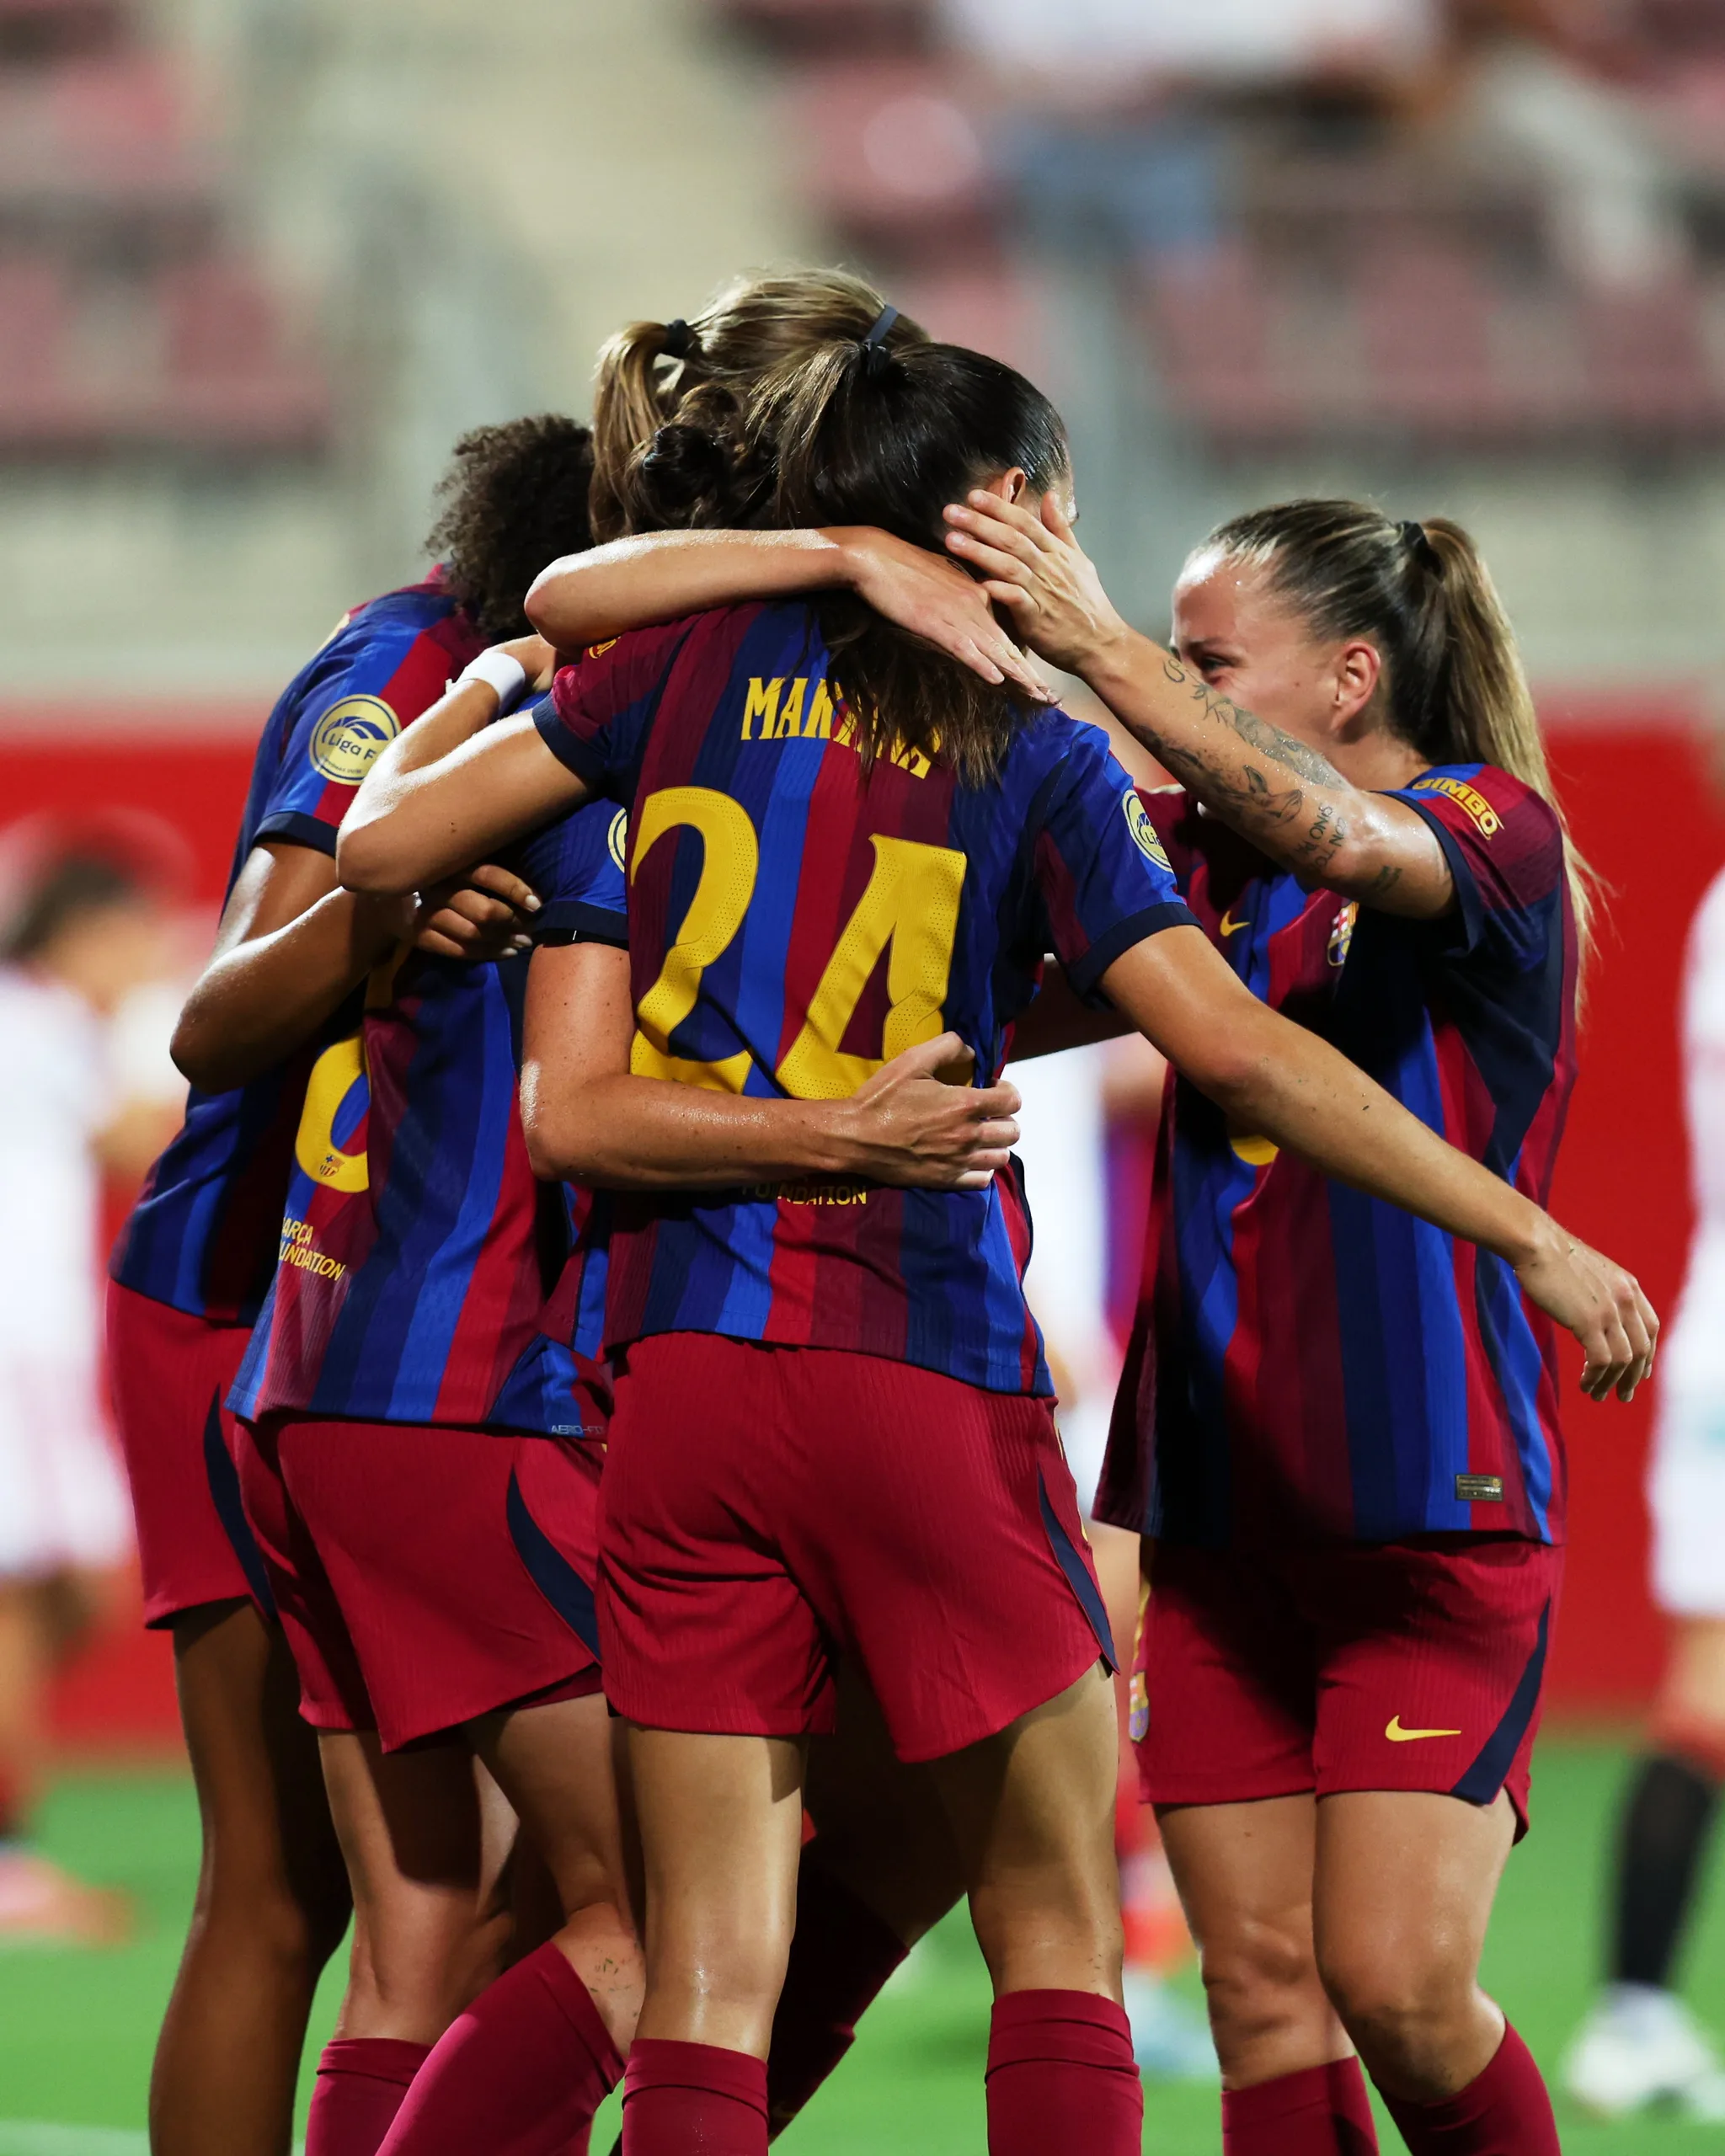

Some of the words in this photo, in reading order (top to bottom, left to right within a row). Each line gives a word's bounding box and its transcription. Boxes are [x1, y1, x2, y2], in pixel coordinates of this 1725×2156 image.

[328, 733, 362, 755] Liga
[363, 748, 377, 760] F
[1412, 777, 1498, 835] BIMBO
[630, 786, 973, 1100] 24
[281, 1216, 313, 1246] ARÇA
